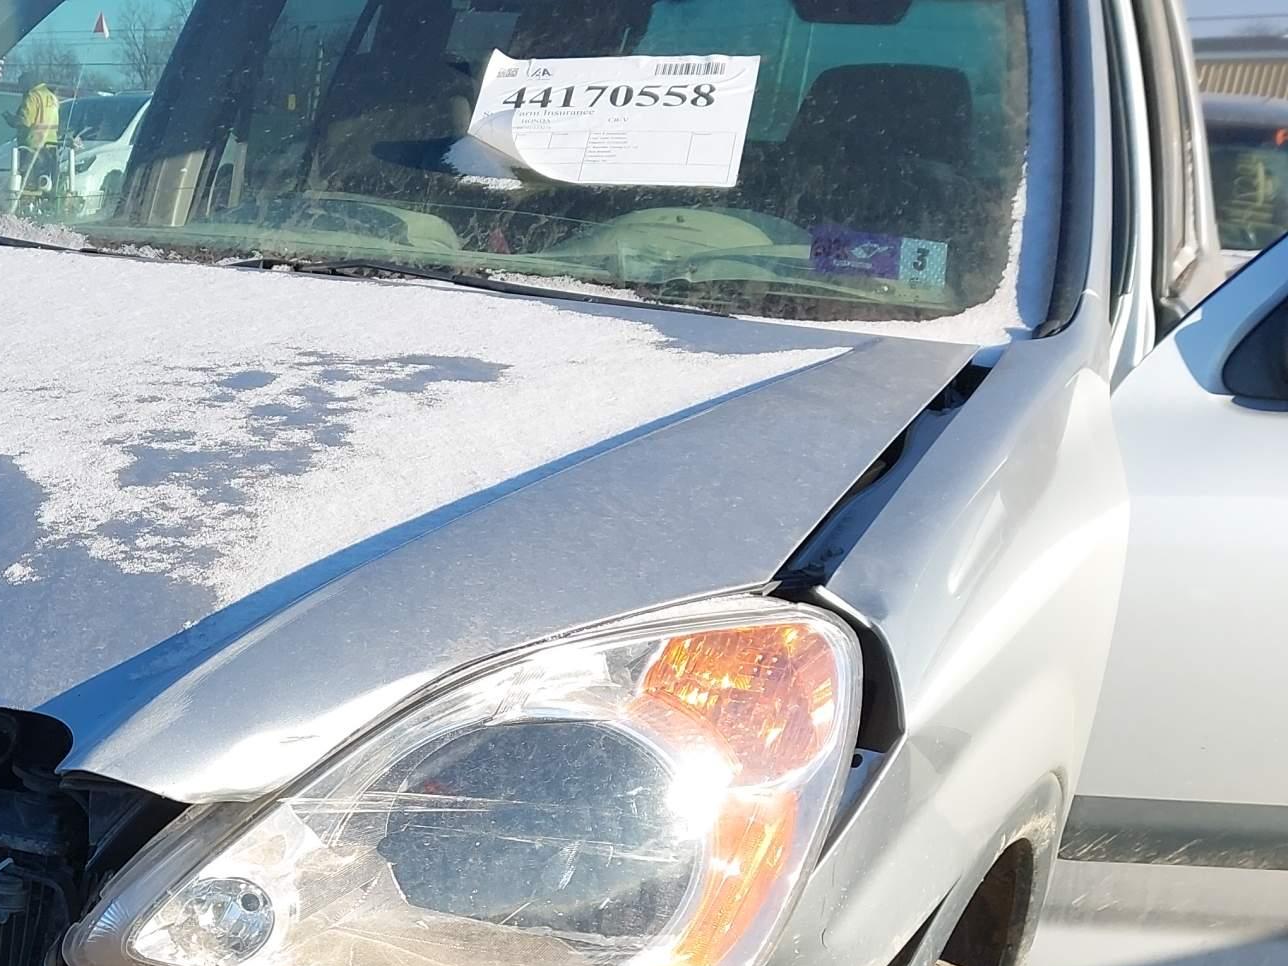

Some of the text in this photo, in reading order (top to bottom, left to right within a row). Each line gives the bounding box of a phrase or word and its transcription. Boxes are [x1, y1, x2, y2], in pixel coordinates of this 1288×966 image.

[502, 83, 717, 109] 44170558
[543, 109, 596, 117] Insurance
[912, 247, 931, 271] 3
